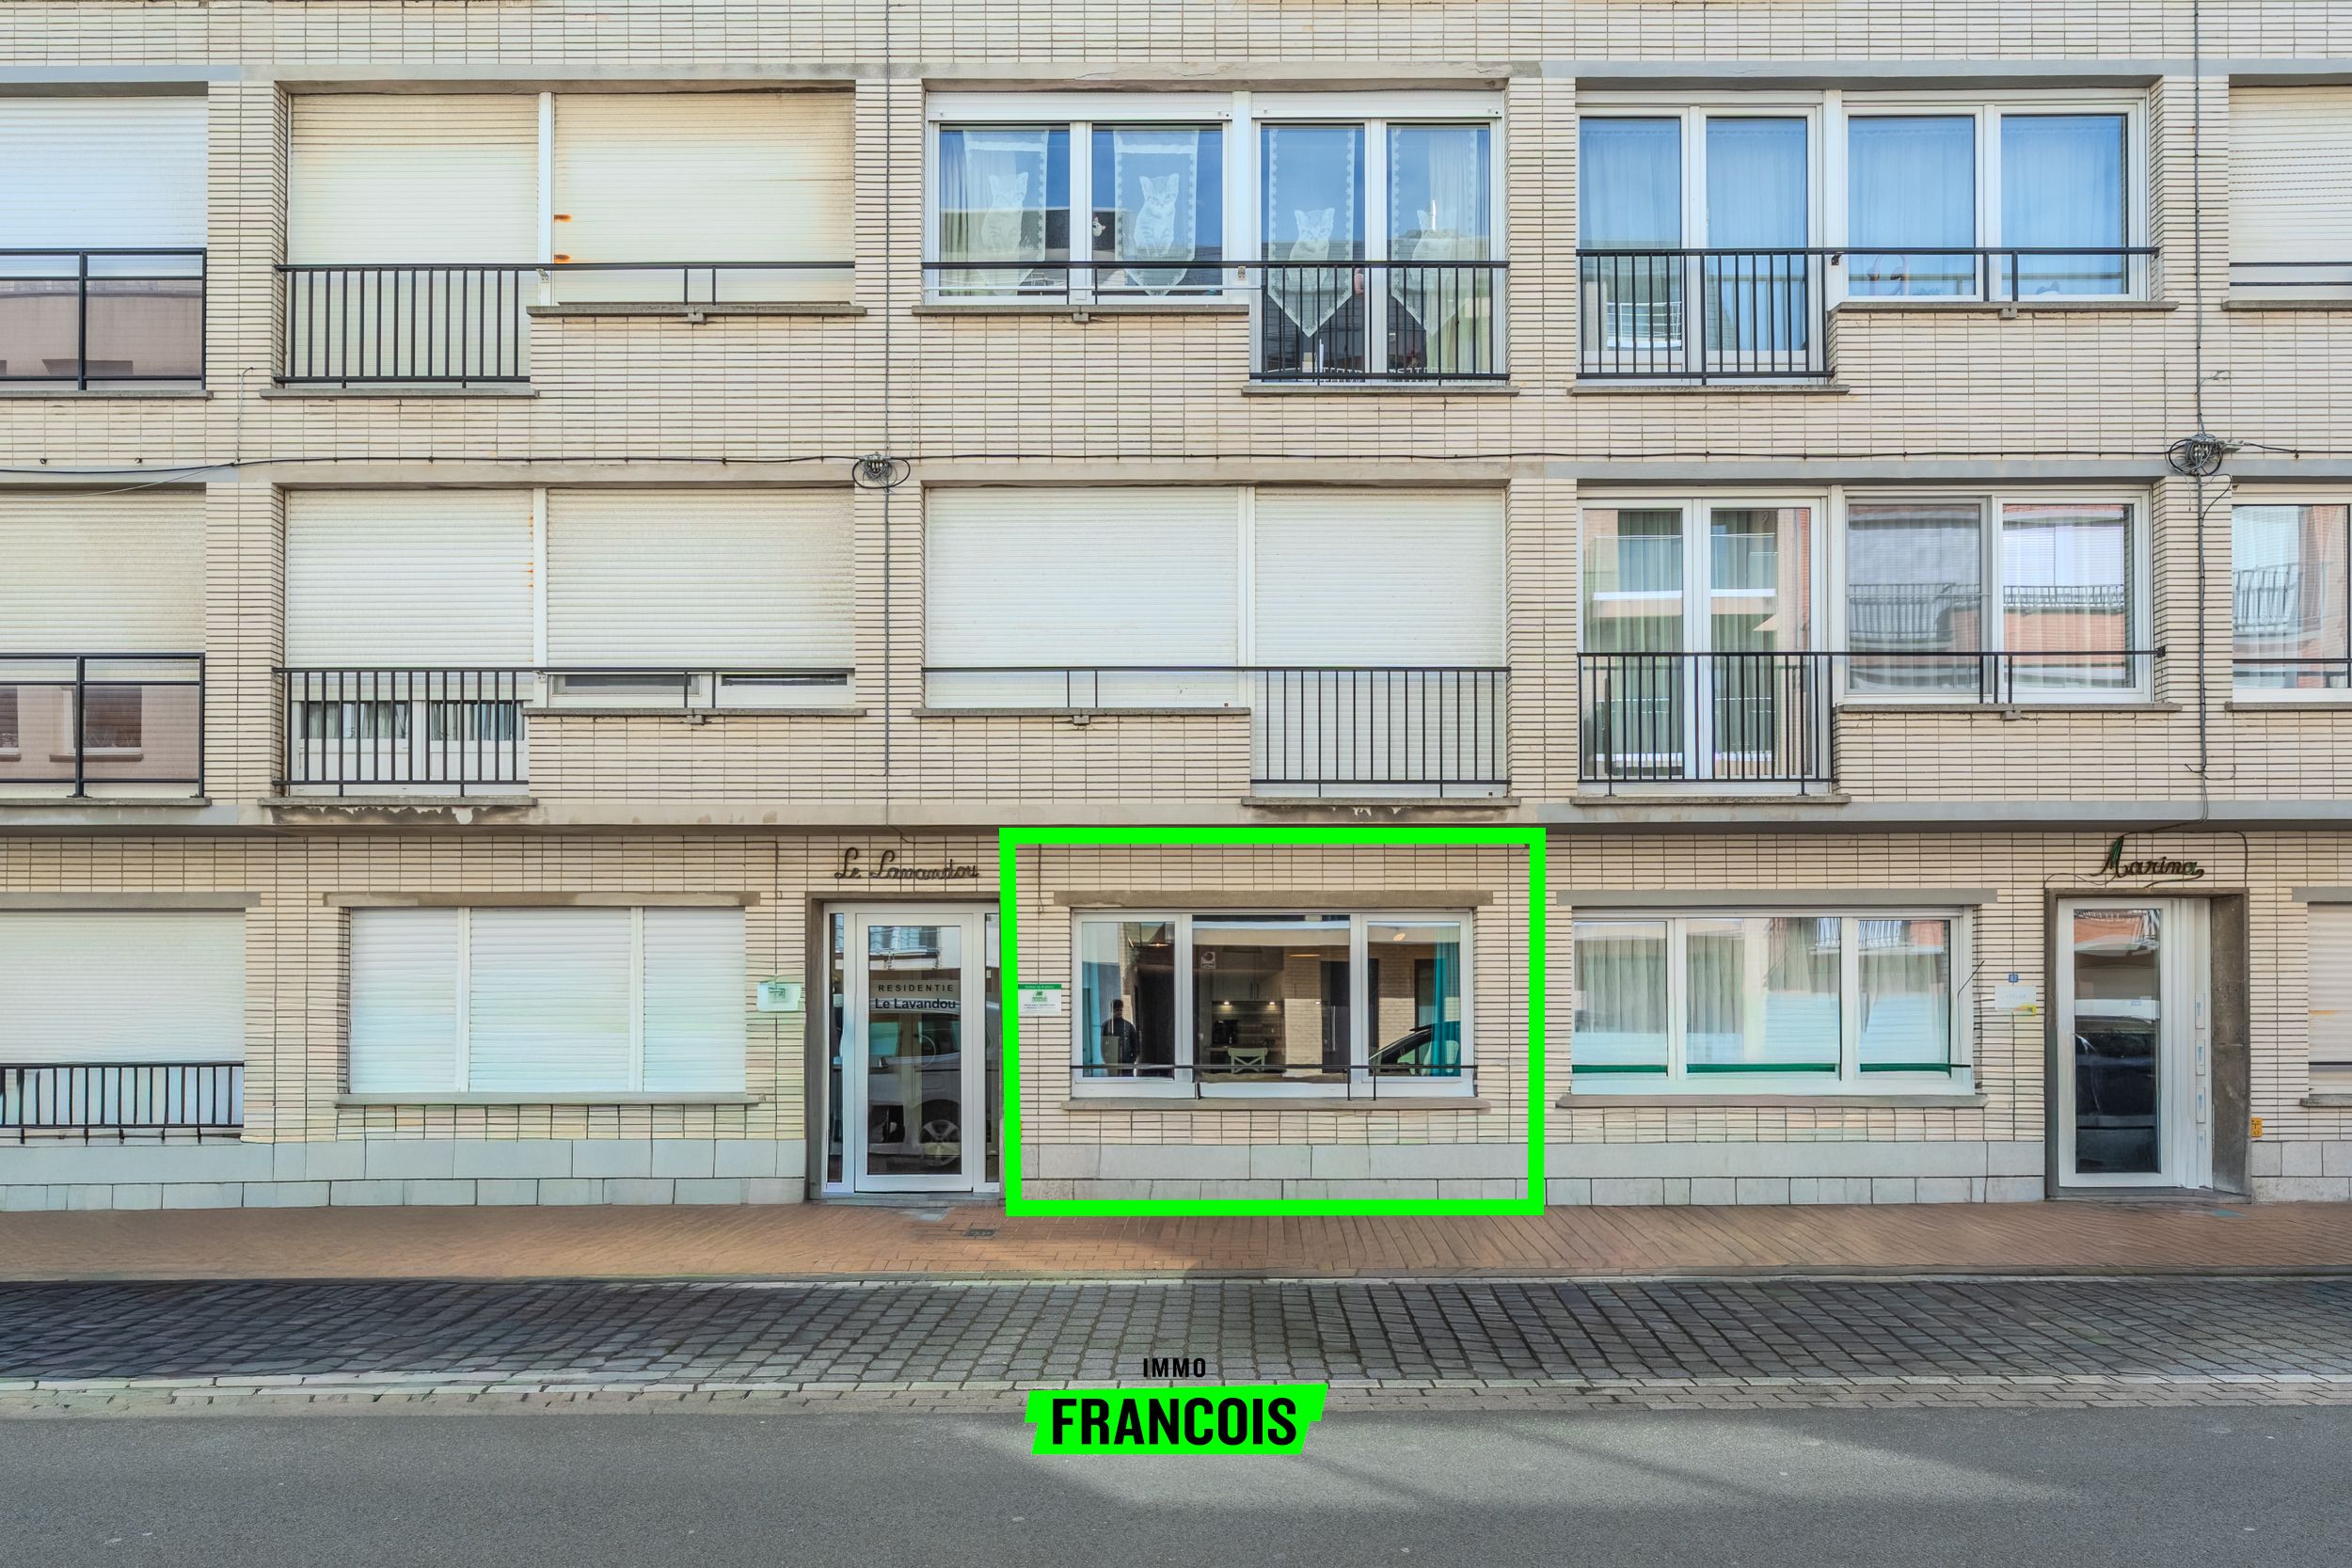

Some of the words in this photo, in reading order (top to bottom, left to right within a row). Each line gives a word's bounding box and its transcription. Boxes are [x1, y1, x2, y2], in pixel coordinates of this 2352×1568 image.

[834, 847, 862, 879] Le
[2090, 835, 2205, 879] Marina
[878, 984, 954, 992] RESIDENTIE
[875, 998, 890, 1009] Le
[894, 998, 957, 1009] Lavandou
